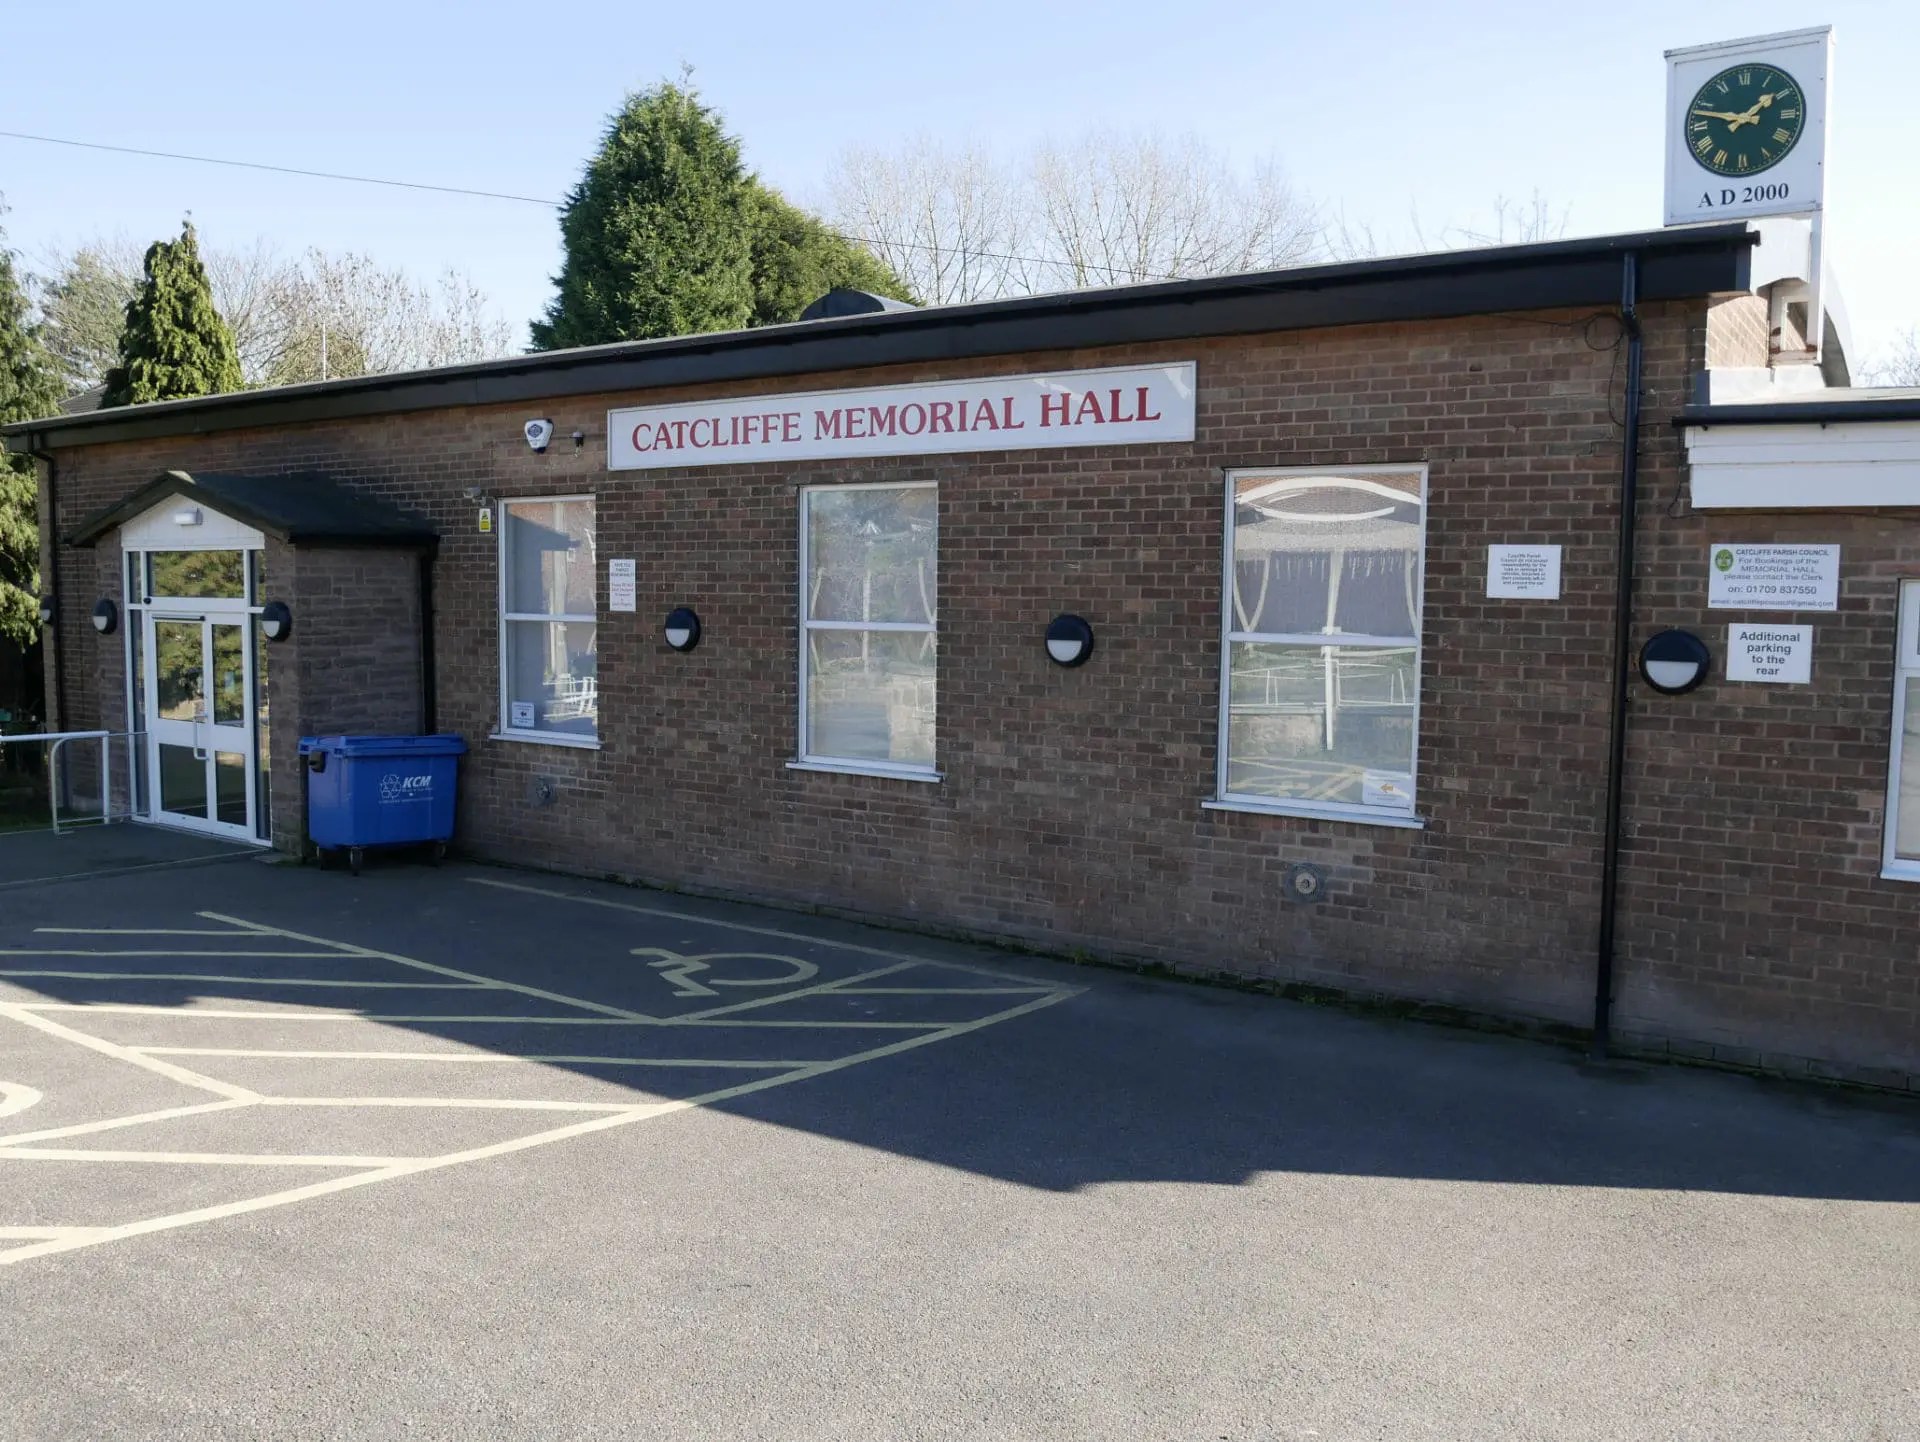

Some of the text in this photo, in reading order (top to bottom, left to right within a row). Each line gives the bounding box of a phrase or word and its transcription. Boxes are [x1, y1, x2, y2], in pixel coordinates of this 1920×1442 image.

[1698, 182, 1789, 208] A D 2000
[631, 386, 1162, 453] CATCLIFFE MEMORIAL HALL
[1746, 585, 1777, 594] 01709
[1779, 586, 1817, 595] 837550
[1739, 631, 1800, 642] Additional
[1747, 644, 1792, 655] parking
[1752, 655, 1785, 664] to the
[1756, 667, 1780, 675] rear
[403, 775, 432, 788] KCM
